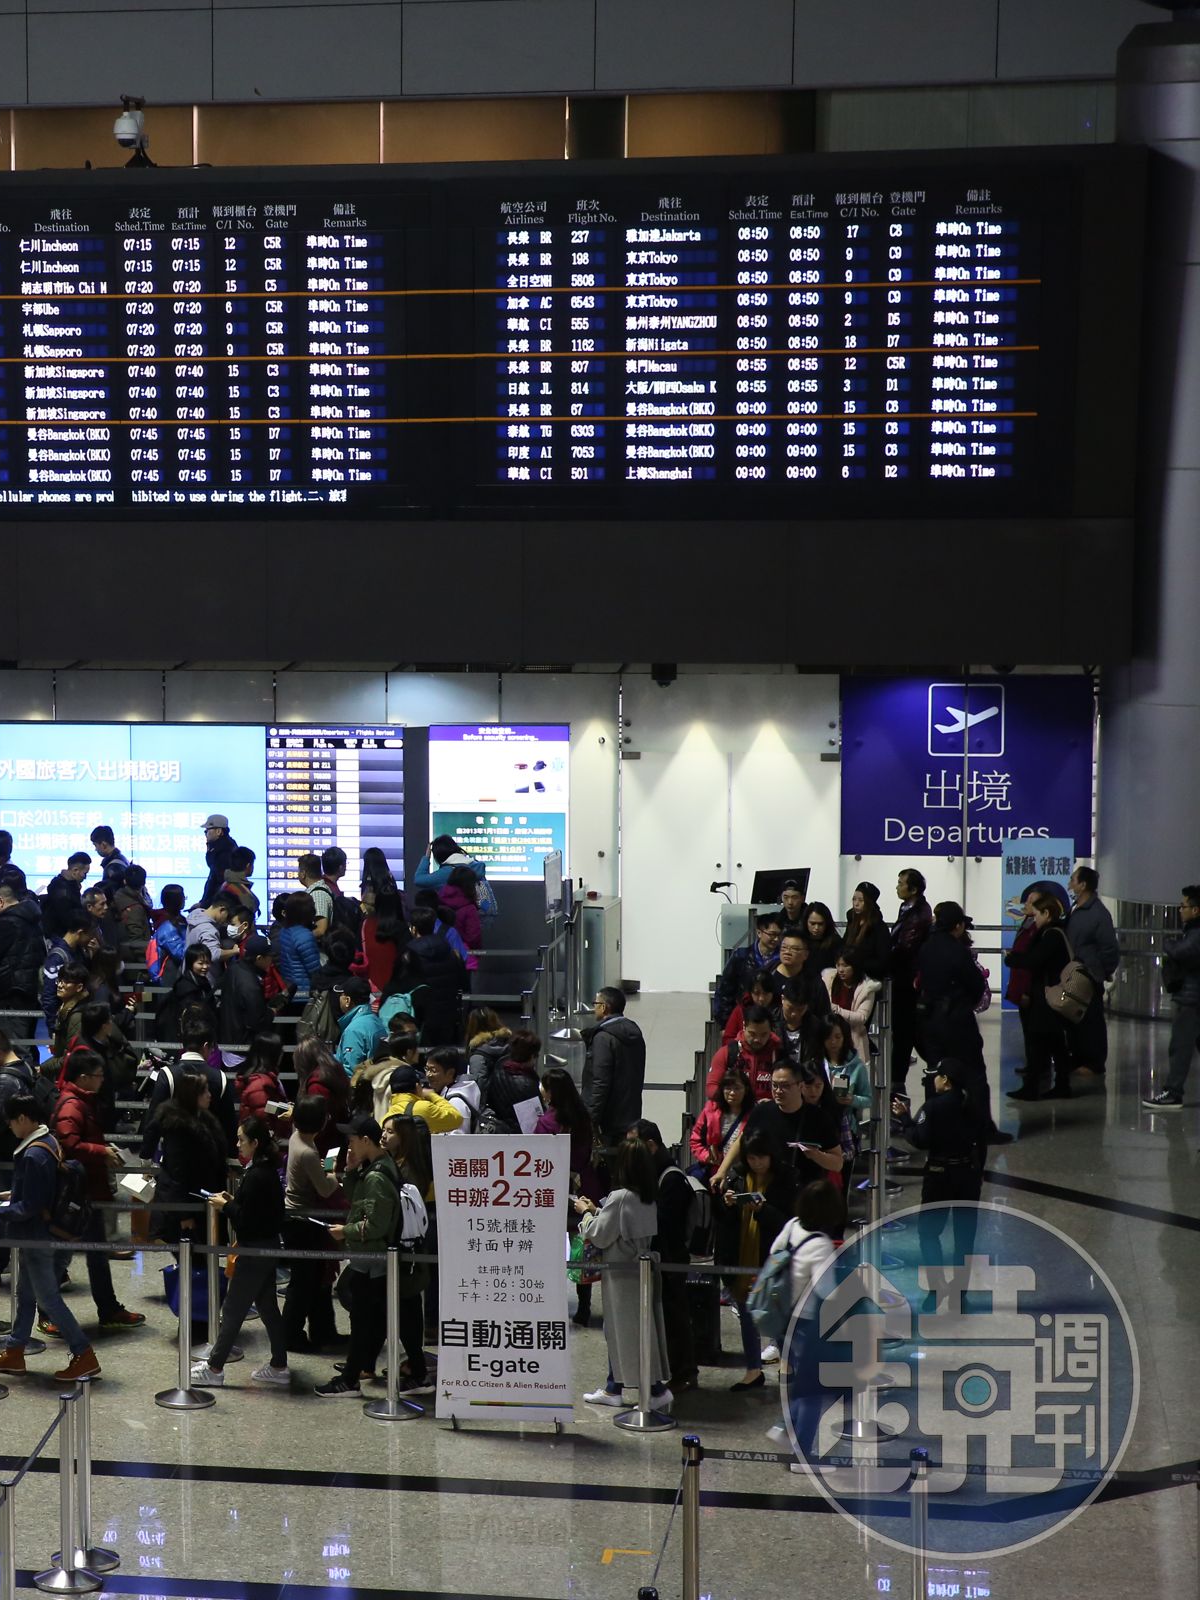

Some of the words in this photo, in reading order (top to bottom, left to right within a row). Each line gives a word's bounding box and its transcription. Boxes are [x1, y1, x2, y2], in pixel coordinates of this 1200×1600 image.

[746, 194, 769, 207] 表定
[792, 193, 816, 207] 預計
[835, 192, 884, 206] 報到櫃台
[890, 190, 926, 204] 登機門
[966, 189, 991, 202] 備註
[500, 200, 547, 214] 航空公司
[576, 199, 600, 211] 班次
[658, 196, 682, 209] 飛往
[955, 203, 1002, 215] Remarks
[50, 208, 73, 221] 飛往
[129, 207, 151, 219] 表定
[177, 206, 200, 219] 預計
[212, 204, 257, 218] 報到櫃台
[263, 204, 297, 217] 登機門
[332, 203, 356, 216] 備註
[641, 210, 700, 222] Destination
[728, 208, 783, 220] Sched.Time
[790, 210, 829, 219] Est.Time
[839, 207, 858, 218] C/I
[862, 207, 879, 217] No.
[891, 206, 916, 216] Gate
[215, 219, 232, 230] C/I
[237, 219, 254, 230] No.
[265, 218, 289, 229] Gate
[323, 216, 367, 228] Remarks
[504, 213, 545, 225] Airlines
[569, 212, 597, 225] Flight
[599, 212, 616, 223] No.
[34, 221, 90, 233] Destination
[114, 220, 165, 232] Sched.Time
[171, 221, 207, 231] Est.Time
[540, 253, 551, 265] BR
[572, 253, 589, 265] 198
[626, 251, 678, 264] 東京Tokyo
[738, 249, 768, 262] 08:50
[790, 248, 819, 261] 08:50
[846, 248, 853, 260] 9
[889, 246, 901, 259] C9
[20, 260, 79, 273] 仁川Incheon
[125, 260, 152, 272] 07:15
[172, 259, 200, 271] 07:15
[225, 259, 236, 271] 12
[265, 258, 282, 270] C5R
[571, 382, 589, 394] 814
[737, 380, 766, 392] 08:55
[788, 380, 818, 392] 08:55
[844, 379, 850, 391] 3
[887, 379, 898, 391] D1
[132, 470, 159, 481] 07:45
[179, 470, 206, 481] 07:45
[231, 470, 241, 481] 15
[270, 469, 281, 481] D7
[349, 469, 371, 480] Time
[38, 491, 71, 503] phones
[75, 494, 92, 502] are
[173, 492, 185, 502] to
[189, 494, 206, 502] use
[211, 491, 244, 503] during
[248, 491, 265, 502] the
[923, 769, 1012, 812] 出境
[884, 817, 1050, 849] Departures
[448, 1150, 554, 1178] 通關12秒
[448, 1180, 555, 1208] 申辦2分鐘
[467, 1238, 533, 1253] 對面申辦
[441, 1318, 566, 1350] 自動通關
[468, 1354, 540, 1377] E-gate
[478, 1380, 504, 1388] Citizen
[513, 1381, 533, 1389] Alien
[534, 1382, 566, 1390] Resident
